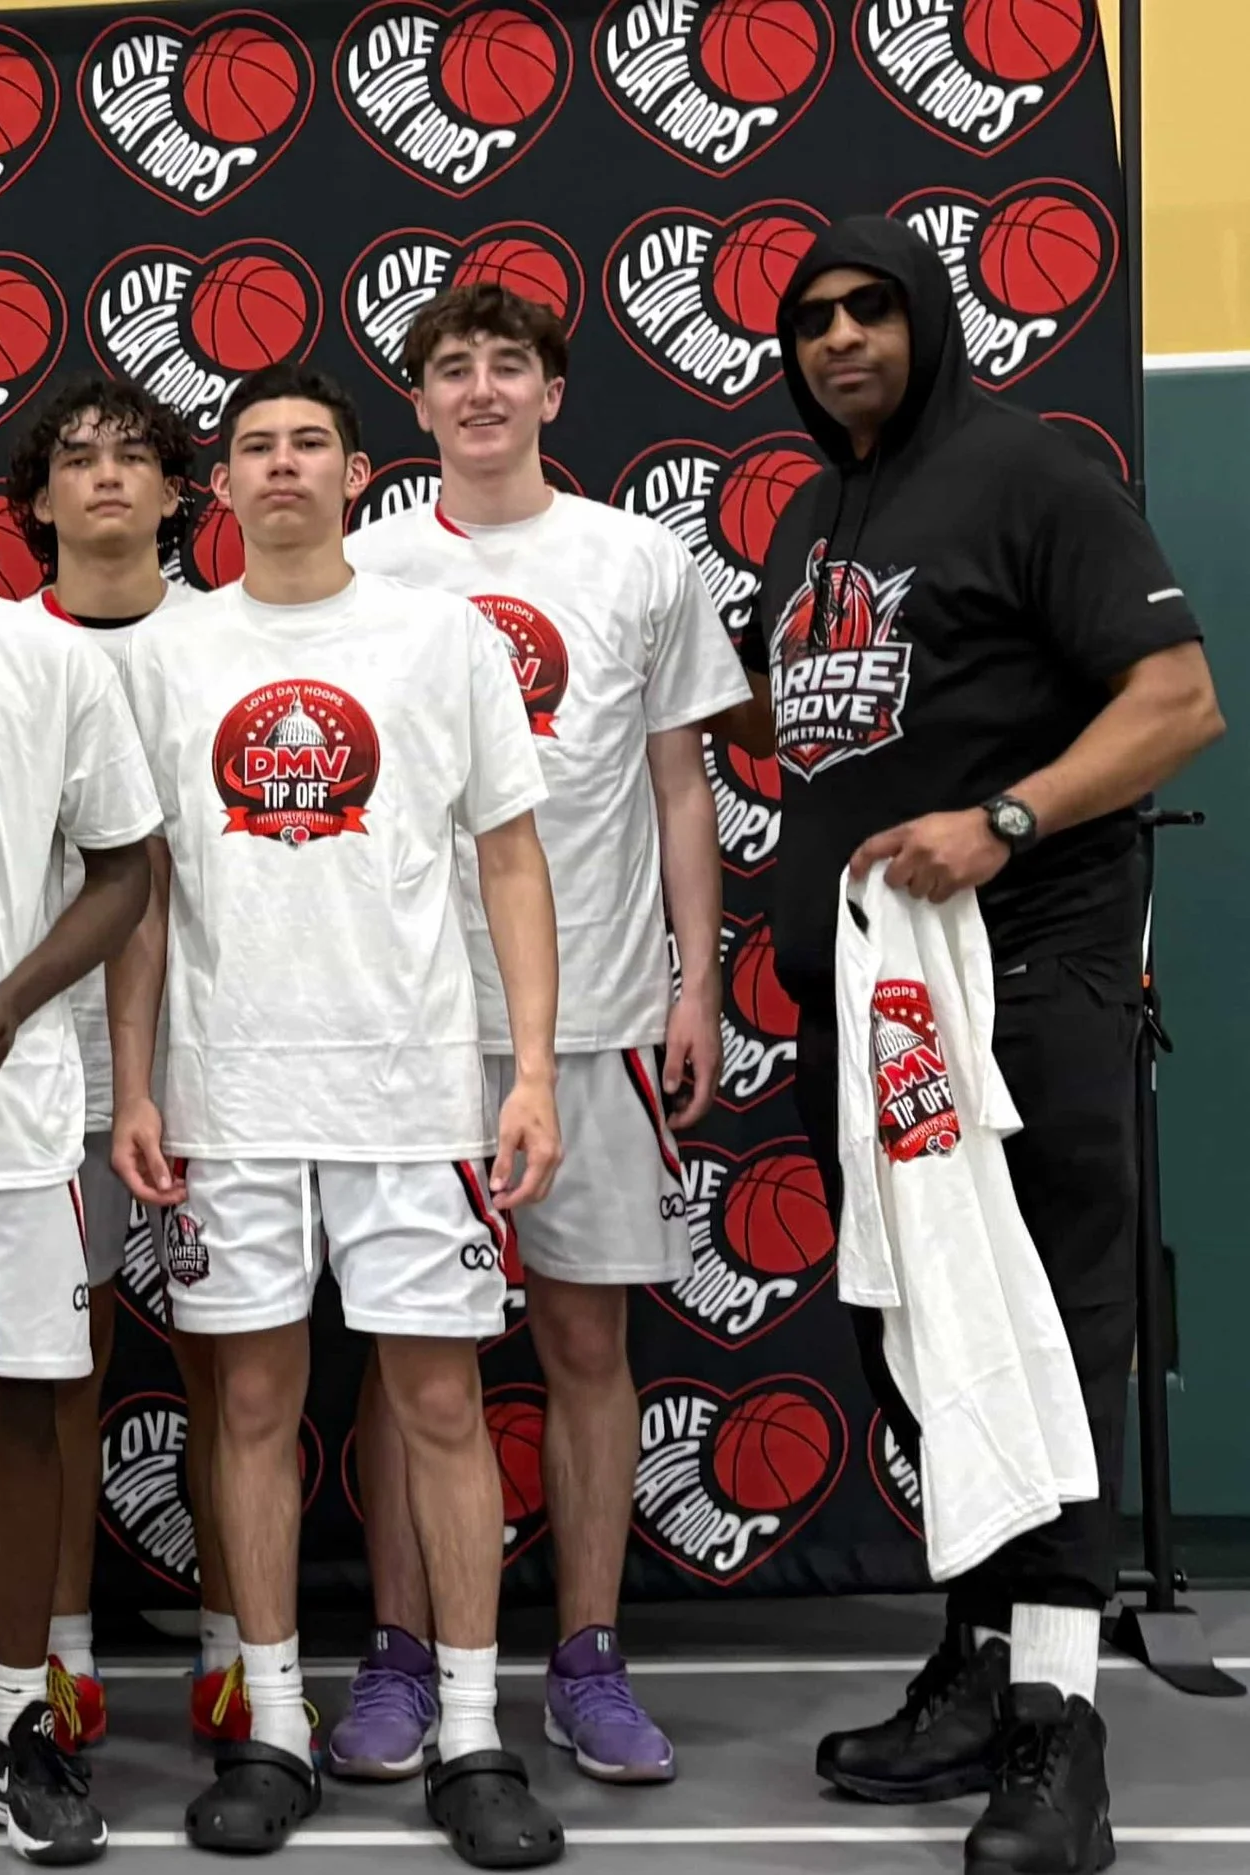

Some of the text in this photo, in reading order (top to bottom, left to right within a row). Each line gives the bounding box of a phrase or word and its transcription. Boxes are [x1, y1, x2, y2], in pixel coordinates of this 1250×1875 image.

[348, 16, 516, 184] LOVE DAY HOOPS
[607, 0, 778, 164] LOVE DAY HOOPS
[868, 0, 1044, 143] LO DAY HOOPS
[93, 35, 257, 202] LOVE DAY HOOPS
[100, 263, 192, 337] LOVE
[357, 246, 452, 323] LOVE
[619, 225, 713, 304] LOVE
[107, 304, 180, 380] DAY
[626, 267, 703, 345] DAY
[665, 311, 782, 395] HOOPS
[244, 685, 345, 712] LOVE DAY HOOPS
[771, 651, 899, 705] ARISE
[776, 694, 877, 729] ABOVE
[245, 746, 351, 786] DMV
[262, 782, 329, 808] TIP OFF
[887, 1077, 952, 1129] TIP OFF
[672, 1160, 798, 1335] VE HOOPS
[102, 1410, 188, 1484] LOVE
[641, 1396, 718, 1450] OVE
[656, 1486, 780, 1572] HOOPS
